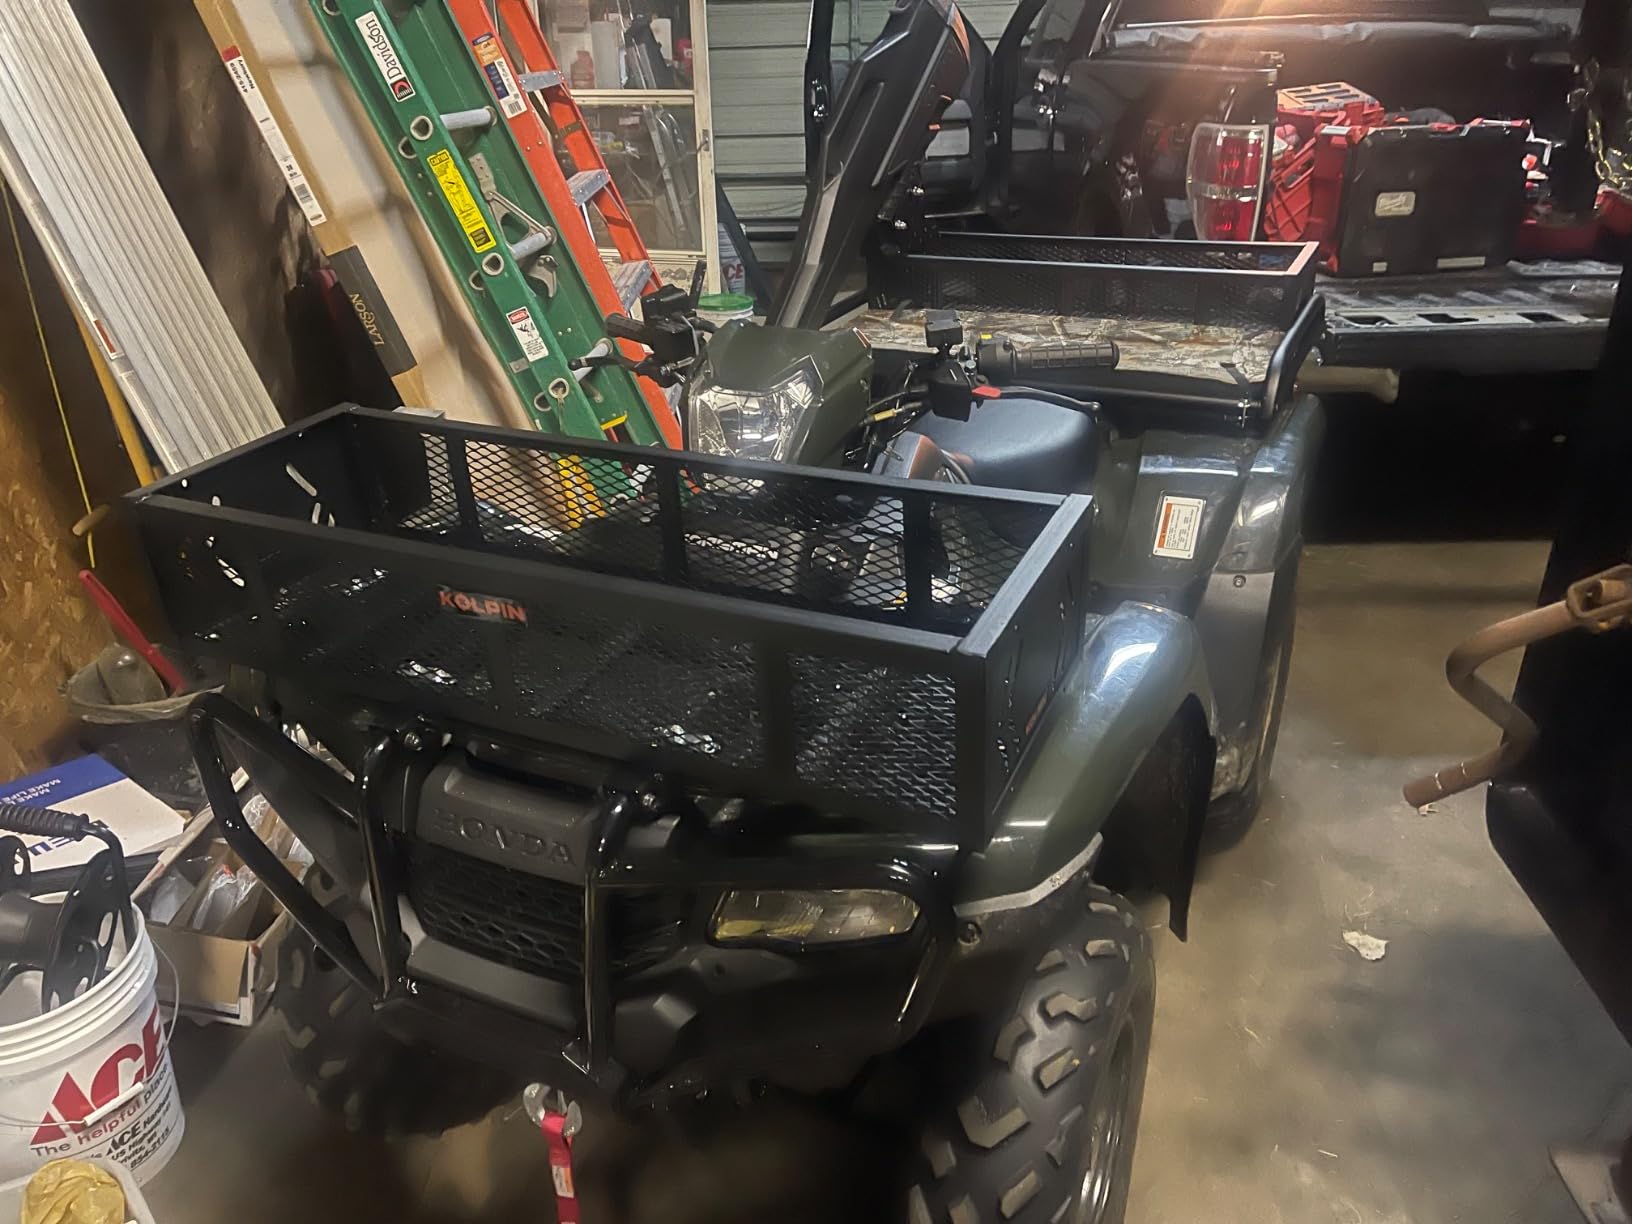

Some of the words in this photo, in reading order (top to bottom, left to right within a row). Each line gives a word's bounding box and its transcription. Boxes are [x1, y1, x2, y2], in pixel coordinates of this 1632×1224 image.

[365, 19, 402, 79] Davidson
[349, 293, 385, 345] LARSON
[439, 591, 528, 622] KOLPIN
[26, 779, 61, 791] MAKE
[434, 807, 575, 865] HONDA
[30, 1007, 166, 1145] ACE
[31, 1142, 71, 1158] The
[77, 1099, 140, 1145] helpful
[106, 1121, 140, 1156] ACE
[112, 1148, 126, 1160] US
